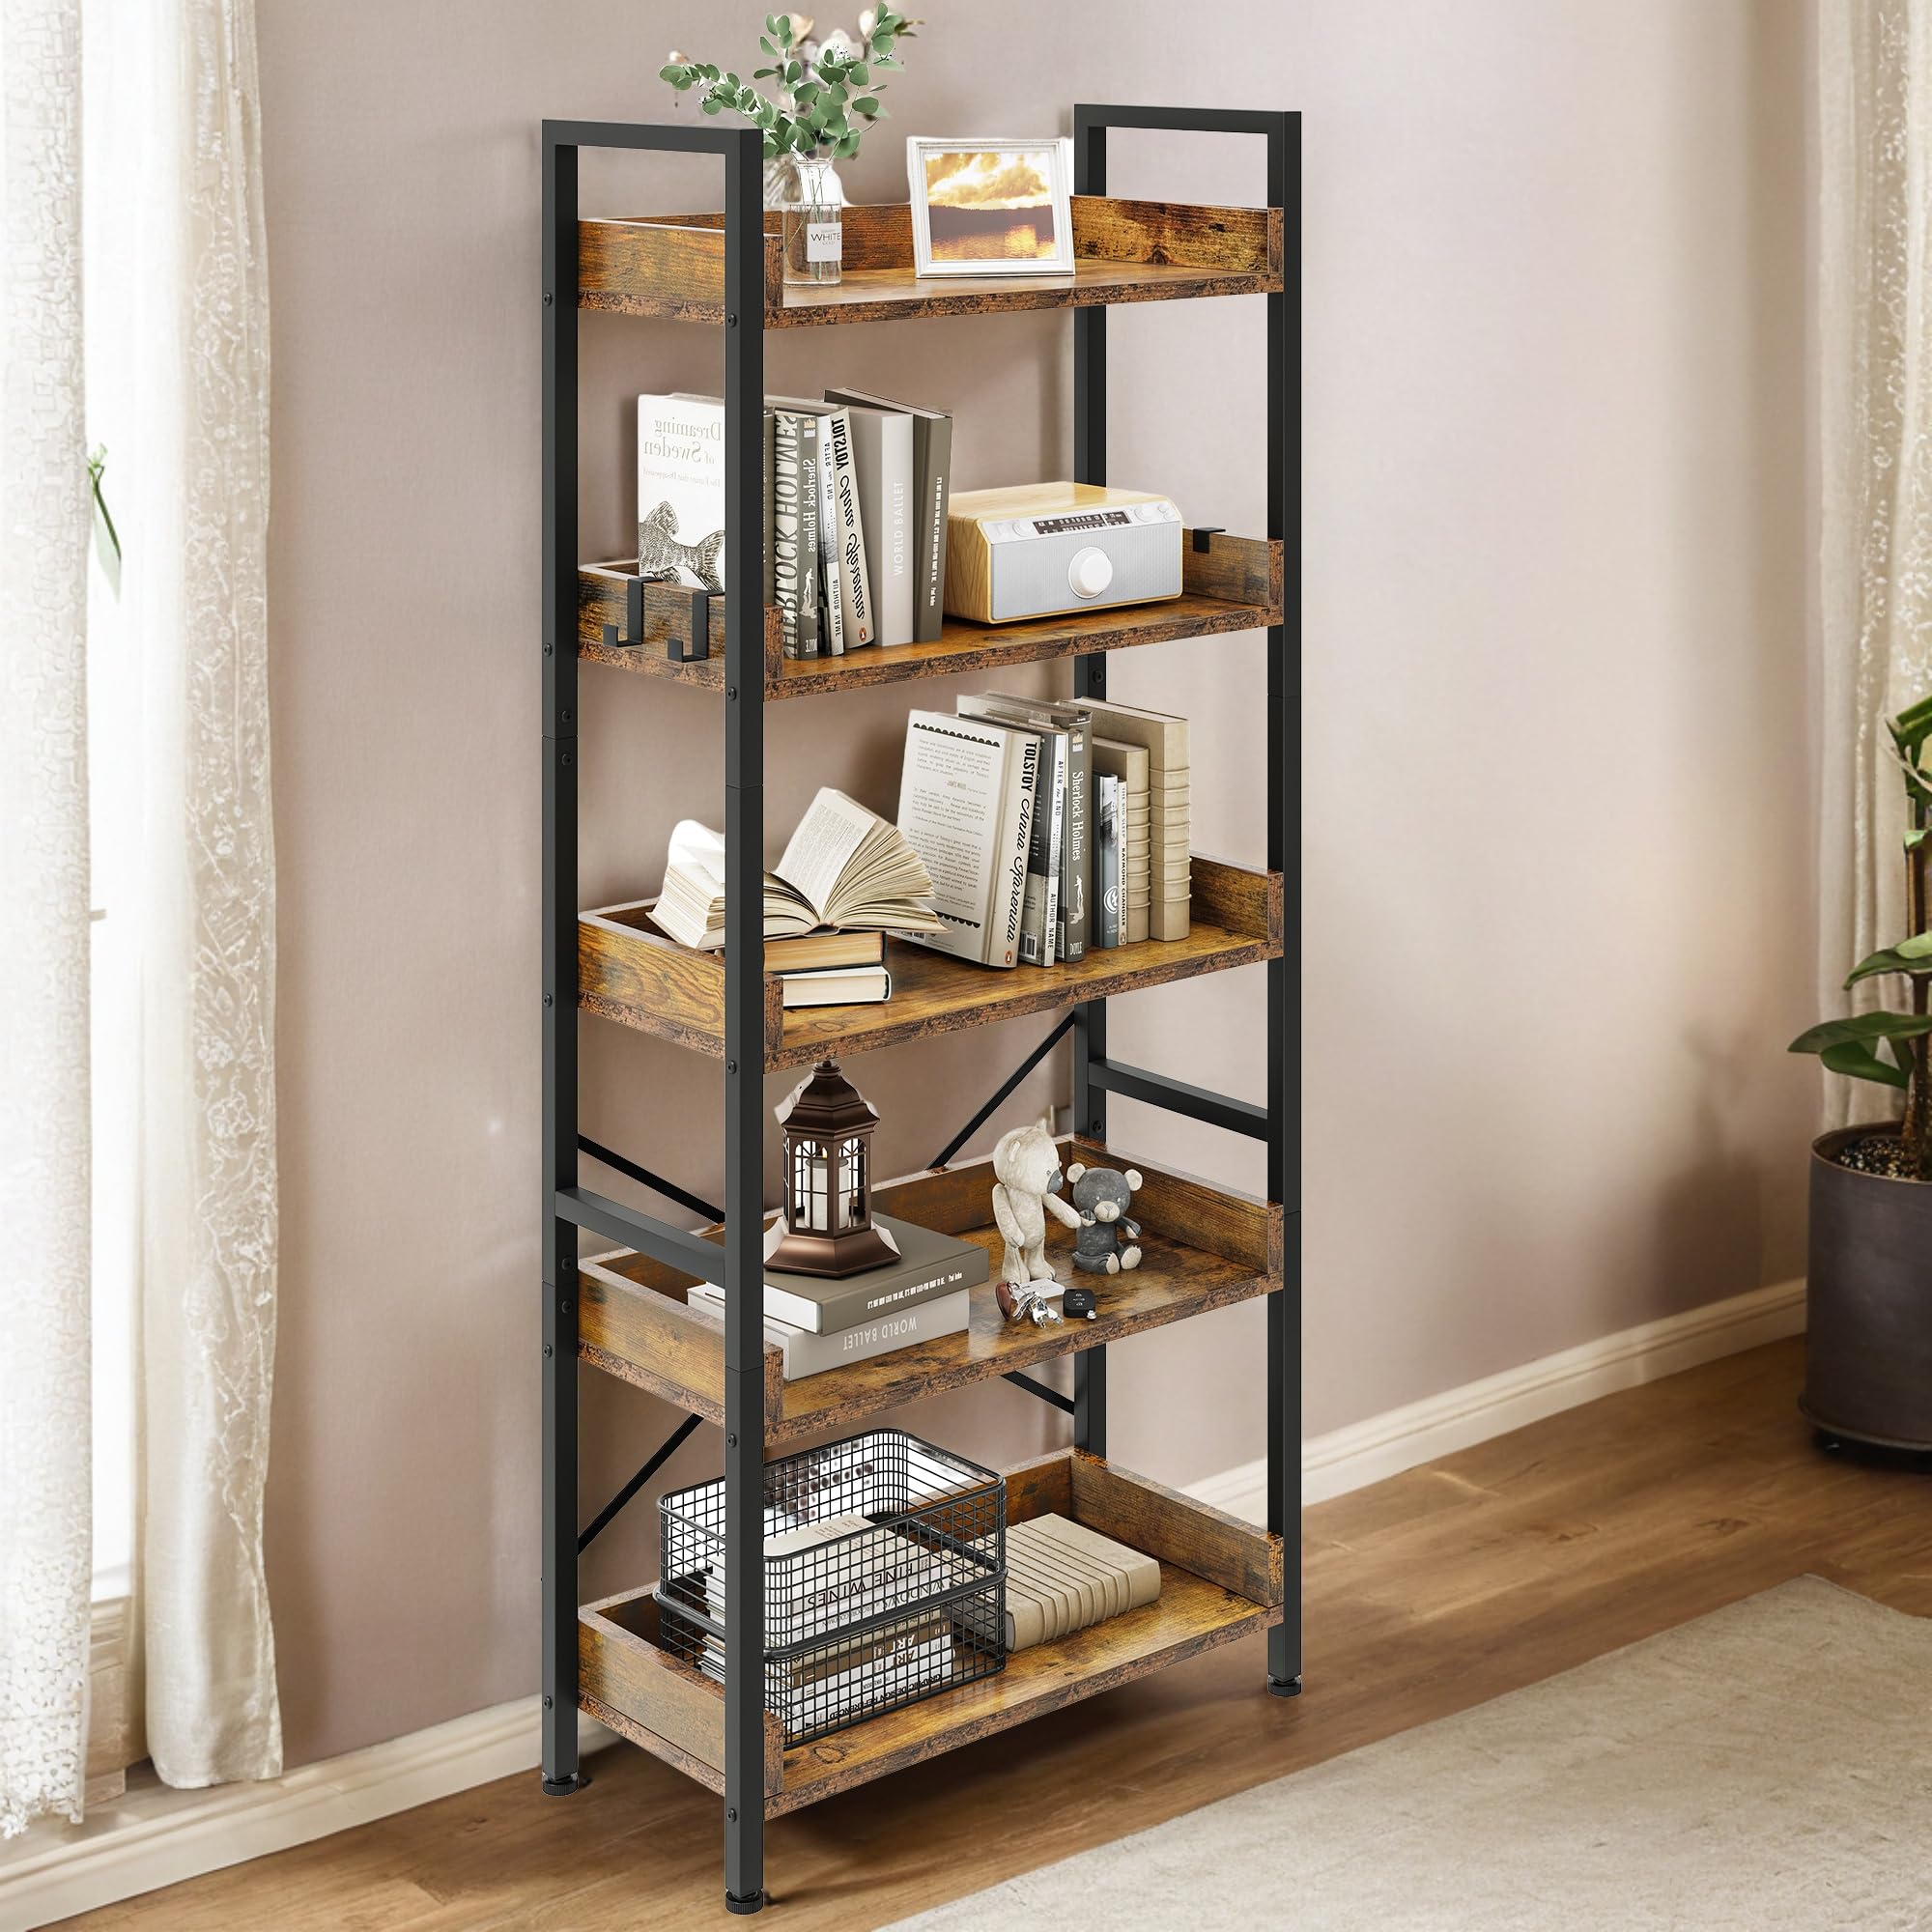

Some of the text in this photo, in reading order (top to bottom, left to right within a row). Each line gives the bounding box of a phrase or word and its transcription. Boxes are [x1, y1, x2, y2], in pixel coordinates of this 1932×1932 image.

[810, 232, 841, 242] WHITE
[893, 481, 904, 577] WORLD BALLET
[1071, 771, 1084, 861] Sherlock Holmes
[1007, 742, 1037, 943] TOLSTOY Anna Karenina
[842, 1317, 918, 1350] WORLD BALLET
[808, 1578, 867, 1610] WINES
[891, 1634, 916, 1653] ART
